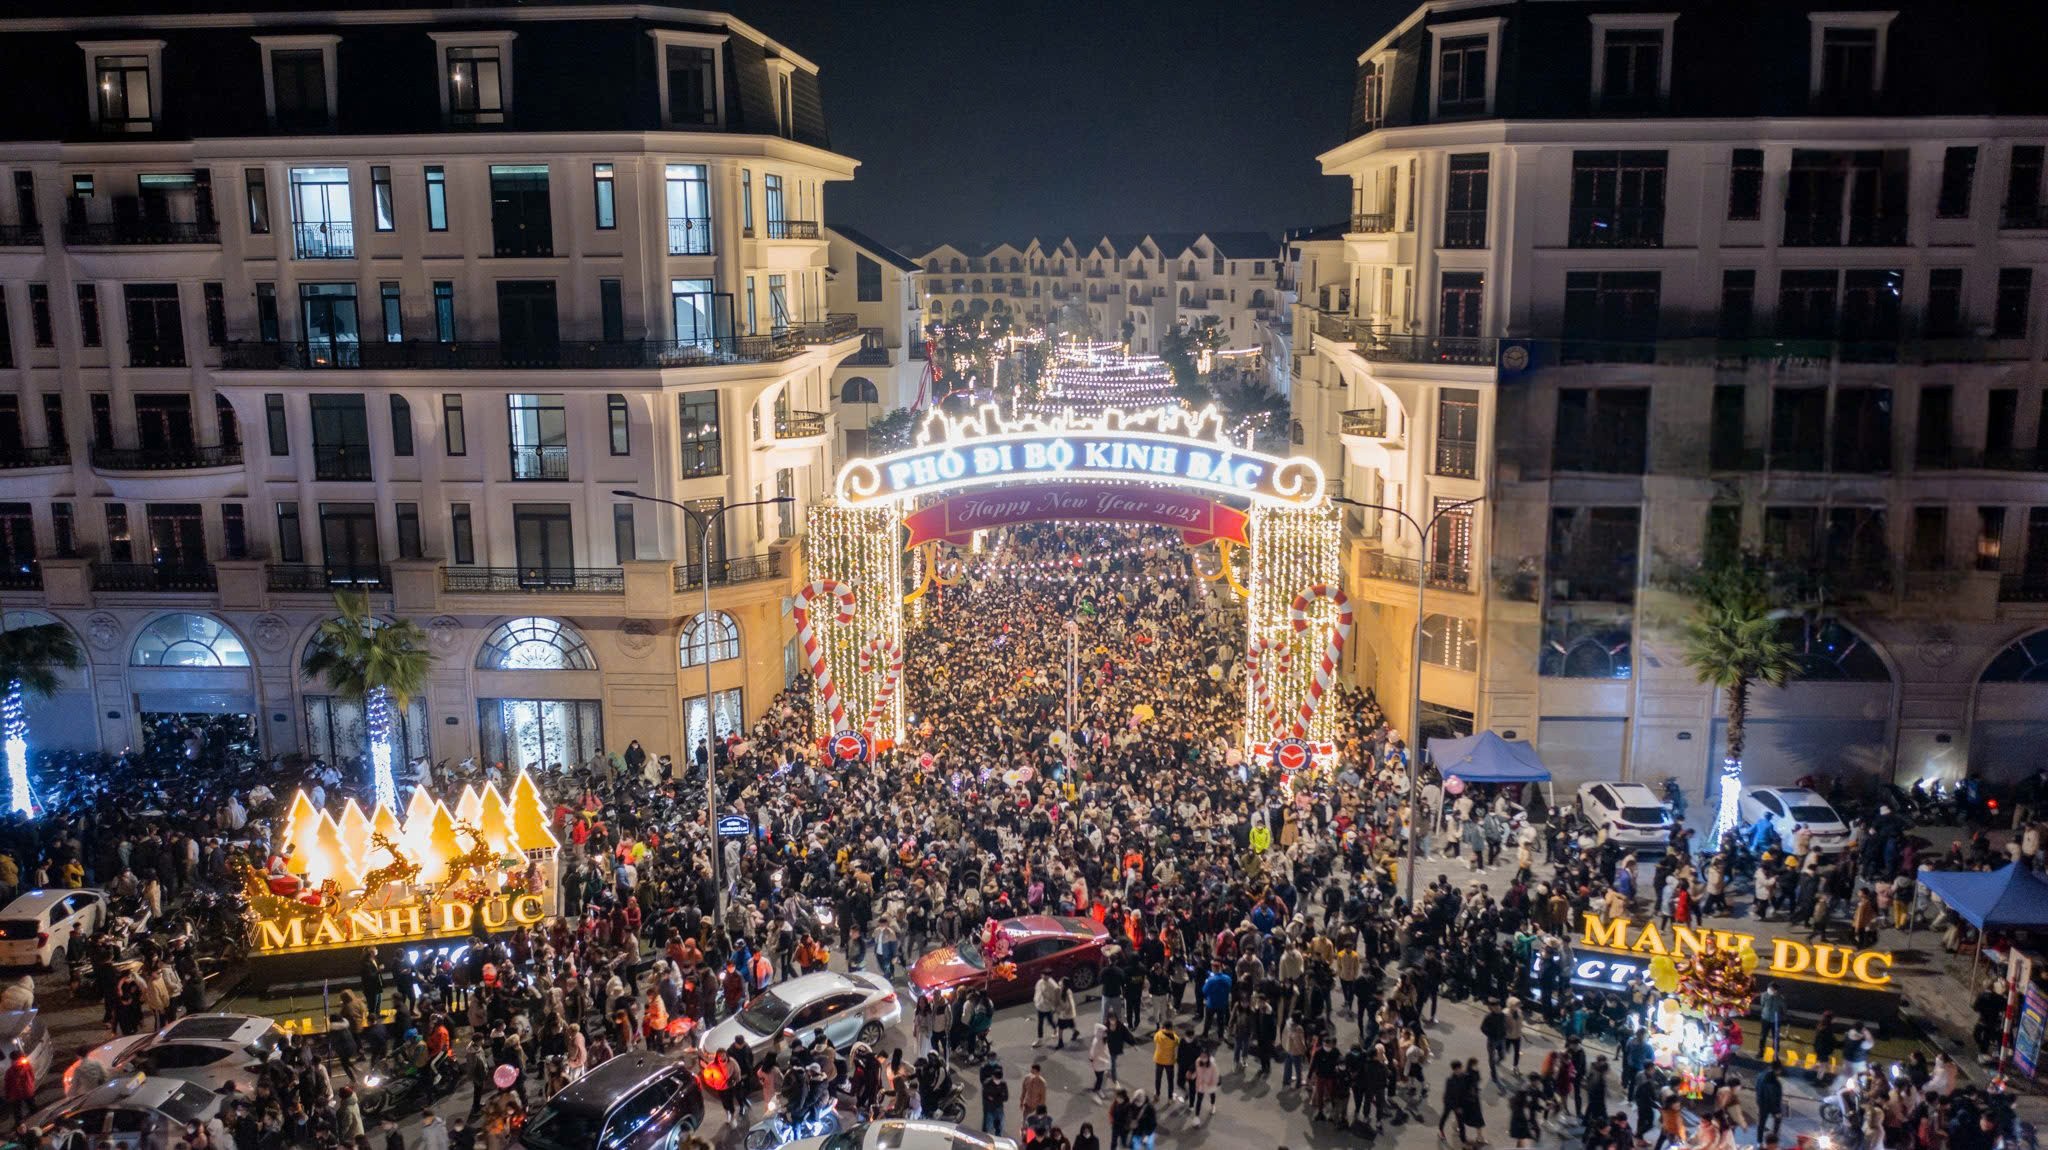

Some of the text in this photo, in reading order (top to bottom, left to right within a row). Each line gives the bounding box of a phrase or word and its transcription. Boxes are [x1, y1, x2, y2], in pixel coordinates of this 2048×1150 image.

[974, 445, 1013, 474] ĐI
[1023, 438, 1074, 472] BỘ
[1084, 442, 1179, 474] KINH
[958, 491, 1201, 522] Happy New Year 2023
[257, 894, 545, 950] MANH DUC
[1581, 911, 1893, 985] MANH DUC
